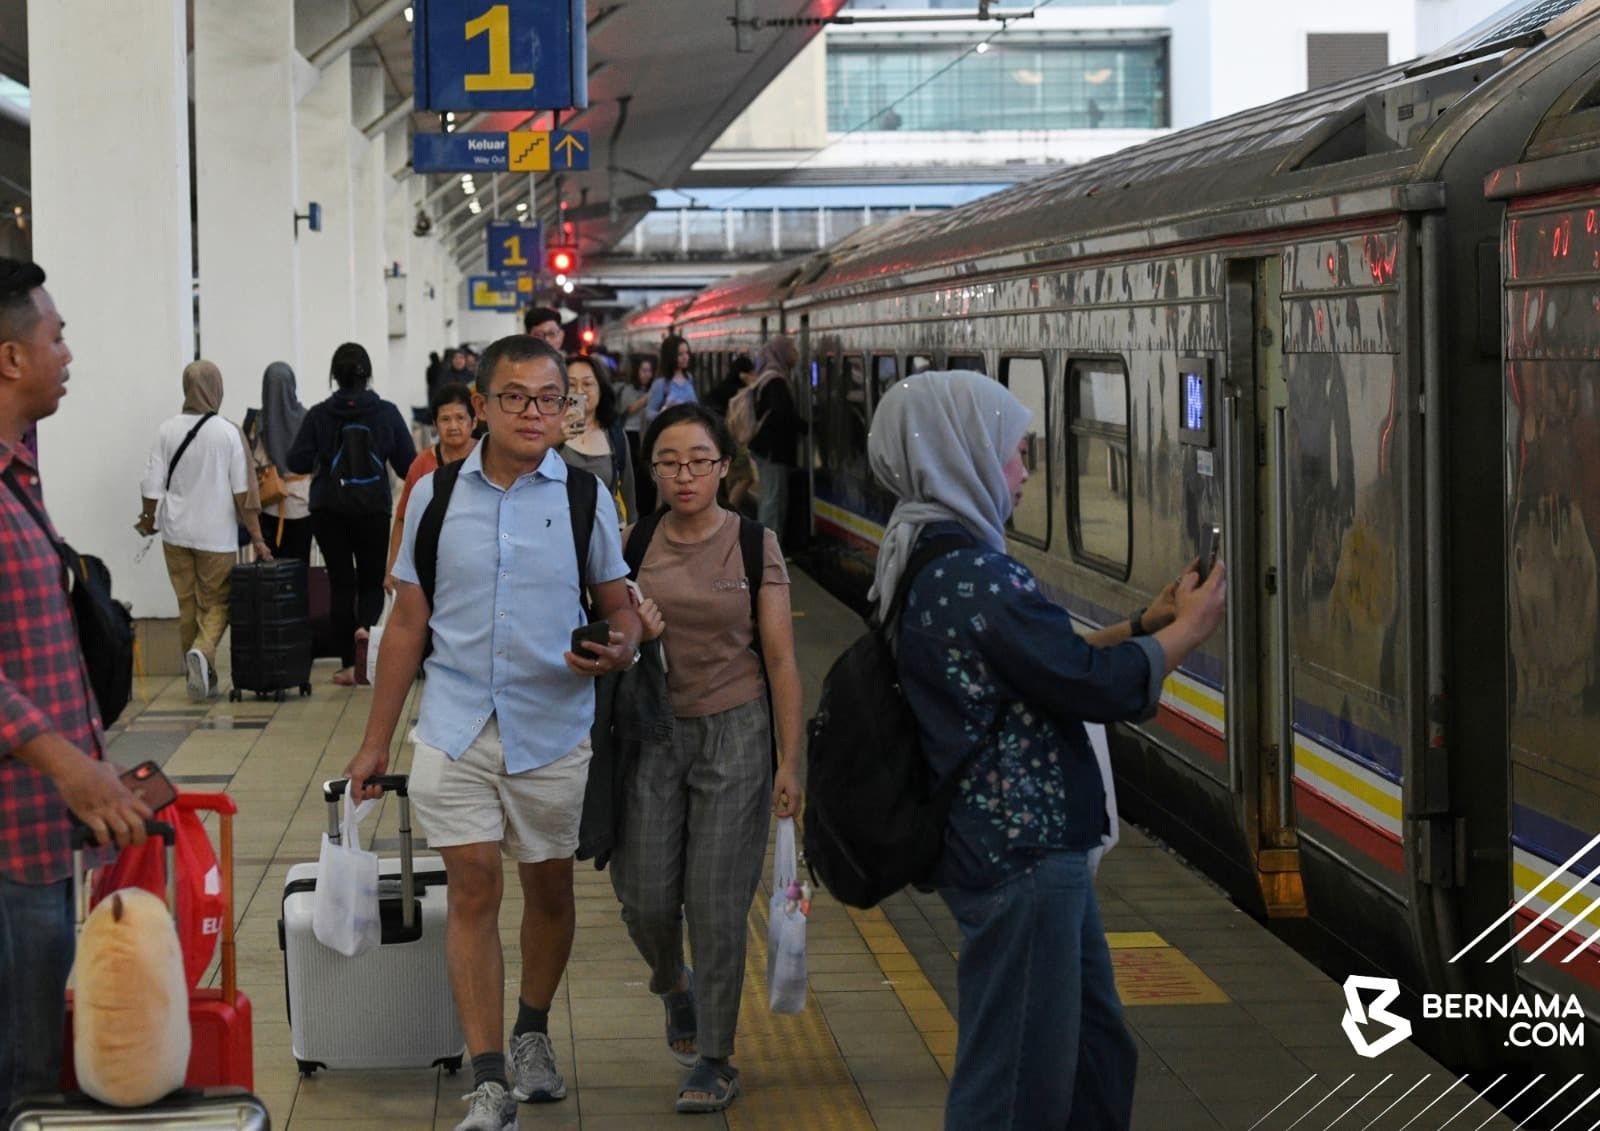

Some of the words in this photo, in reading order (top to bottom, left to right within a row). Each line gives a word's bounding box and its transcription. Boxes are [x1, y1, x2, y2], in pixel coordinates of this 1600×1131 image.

[464, 4, 535, 92] 1
[468, 139, 506, 150] Keluar
[473, 156, 490, 165] Way
[491, 155, 506, 164] Out
[502, 235, 528, 266] 1
